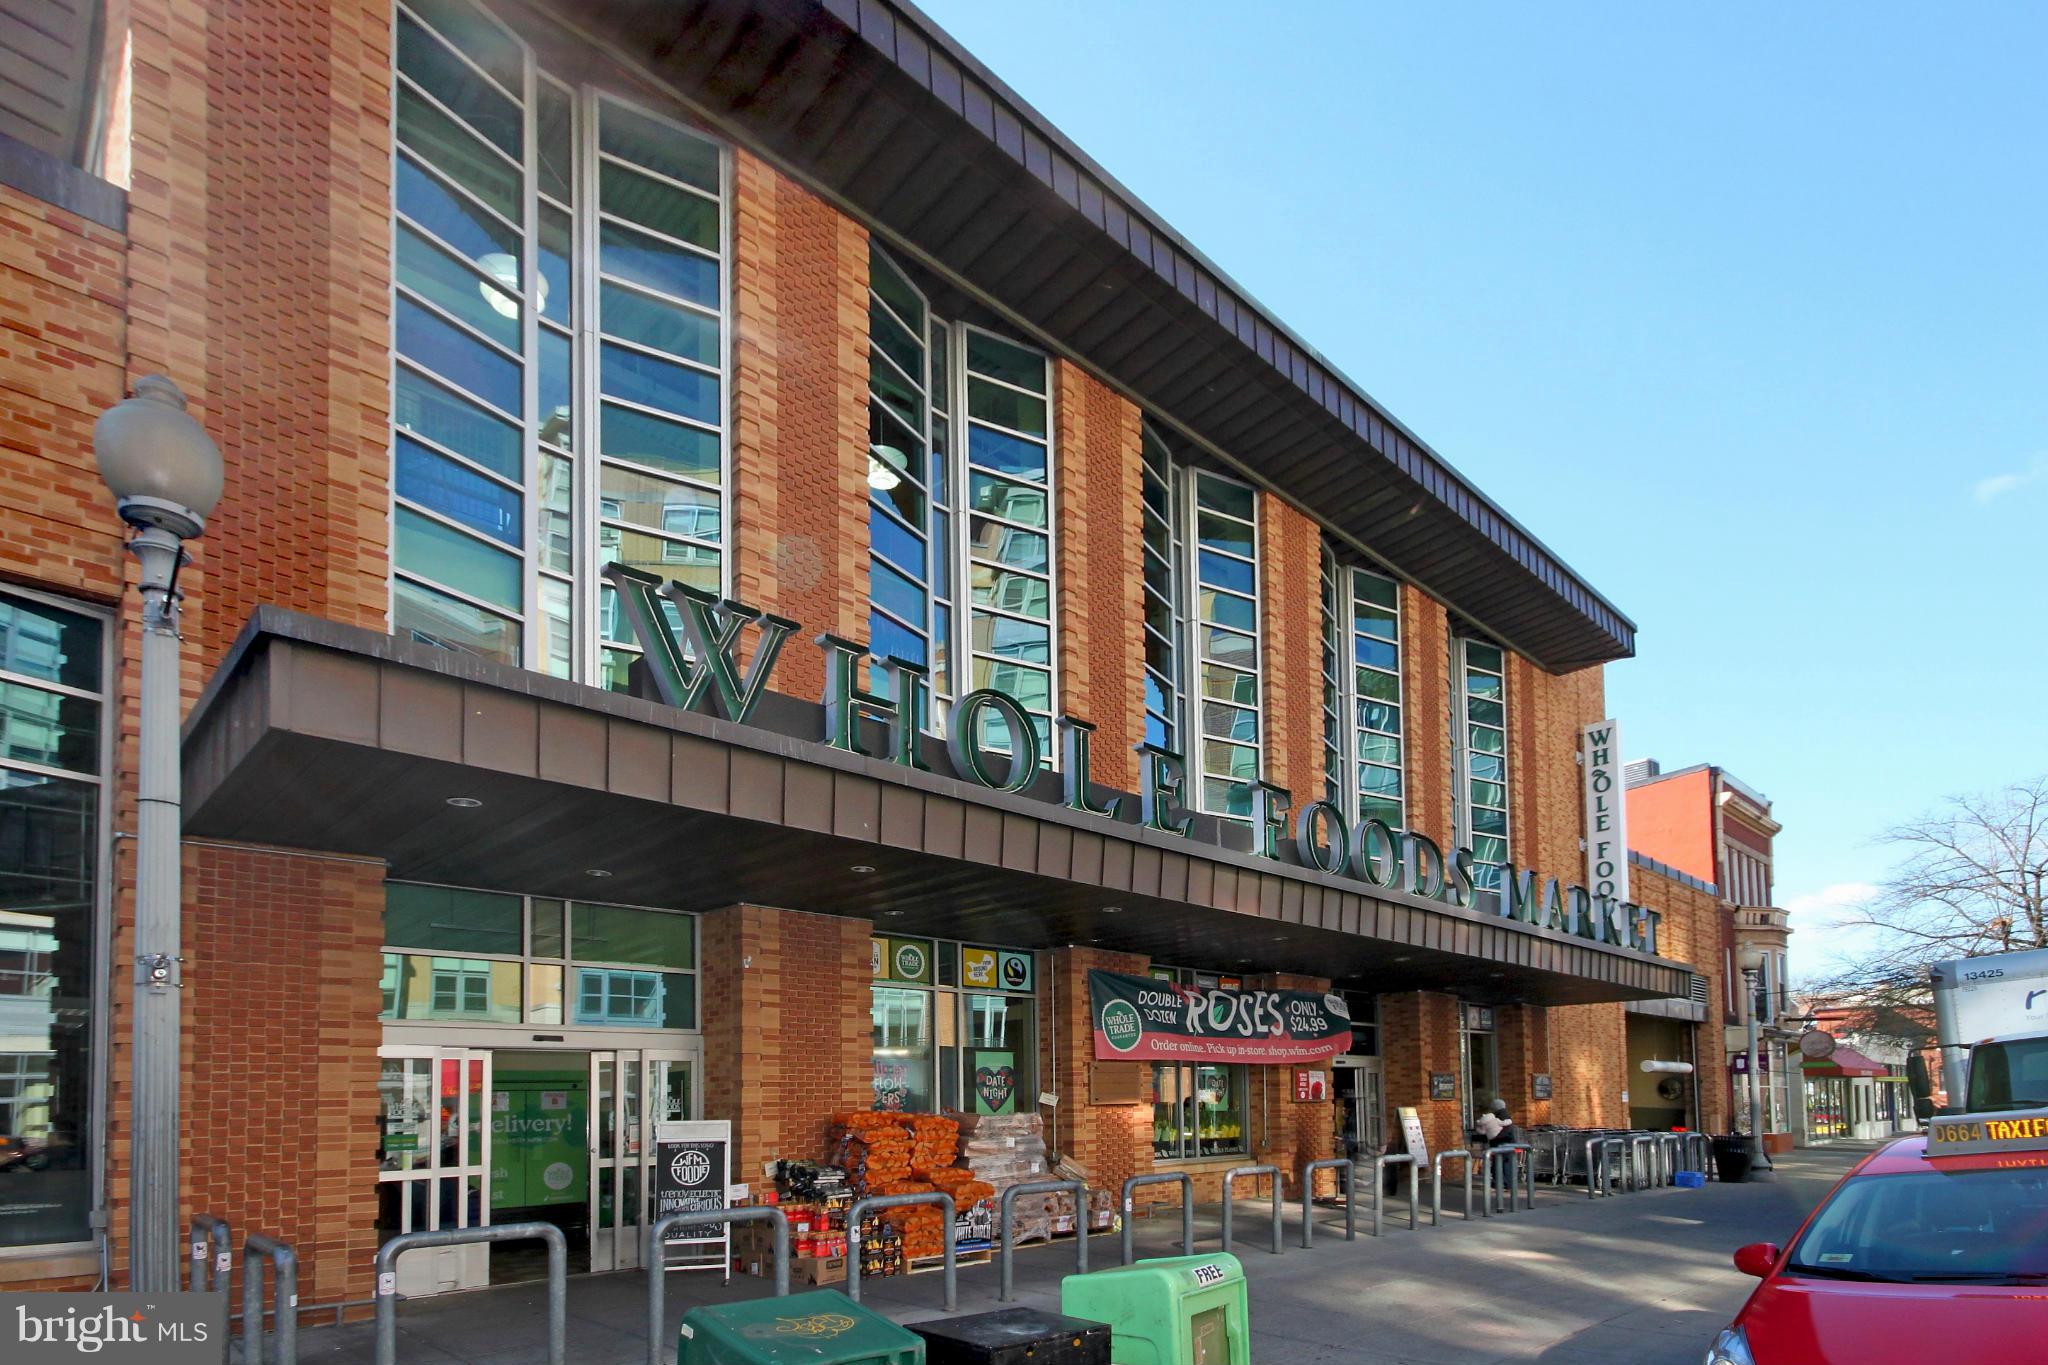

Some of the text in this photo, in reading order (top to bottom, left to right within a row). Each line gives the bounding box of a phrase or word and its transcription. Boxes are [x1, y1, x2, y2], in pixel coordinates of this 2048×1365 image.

[600, 561, 1661, 956] WHOLE FOODS MARKET
[1587, 727, 1615, 897] WHOLE FOO
[1964, 968, 2004, 981] 13425
[1138, 990, 1182, 1008] DOUBLE
[1144, 1008, 1177, 1025] DOZEN
[1183, 989, 1284, 1037] ROSES
[1291, 1000, 1317, 1017] ONLY
[1105, 1012, 1135, 1026] WHOLE
[1290, 1016, 1328, 1033] $24.99
[1108, 1023, 1136, 1035] TRADE
[1151, 1039, 1178, 1051] Order
[1179, 1041, 1206, 1053] online.
[1207, 1043, 1226, 1054] Pick
[1227, 1046, 1237, 1056] up
[1268, 1044, 1333, 1058] shop.wfm.com
[985, 1075, 1006, 1086] DATE
[983, 1087, 1008, 1100] NIGHT
[491, 1113, 572, 1136] elivery!
[1985, 1118, 2048, 1140] TAXIF
[680, 1153, 702, 1166] WFM
[677, 1165, 707, 1183] FOODIE
[661, 1189, 722, 1198] trendy ECLECTIC
[972, 1224, 991, 1239] BIRCH
[1194, 1264, 1224, 1284] FREE
